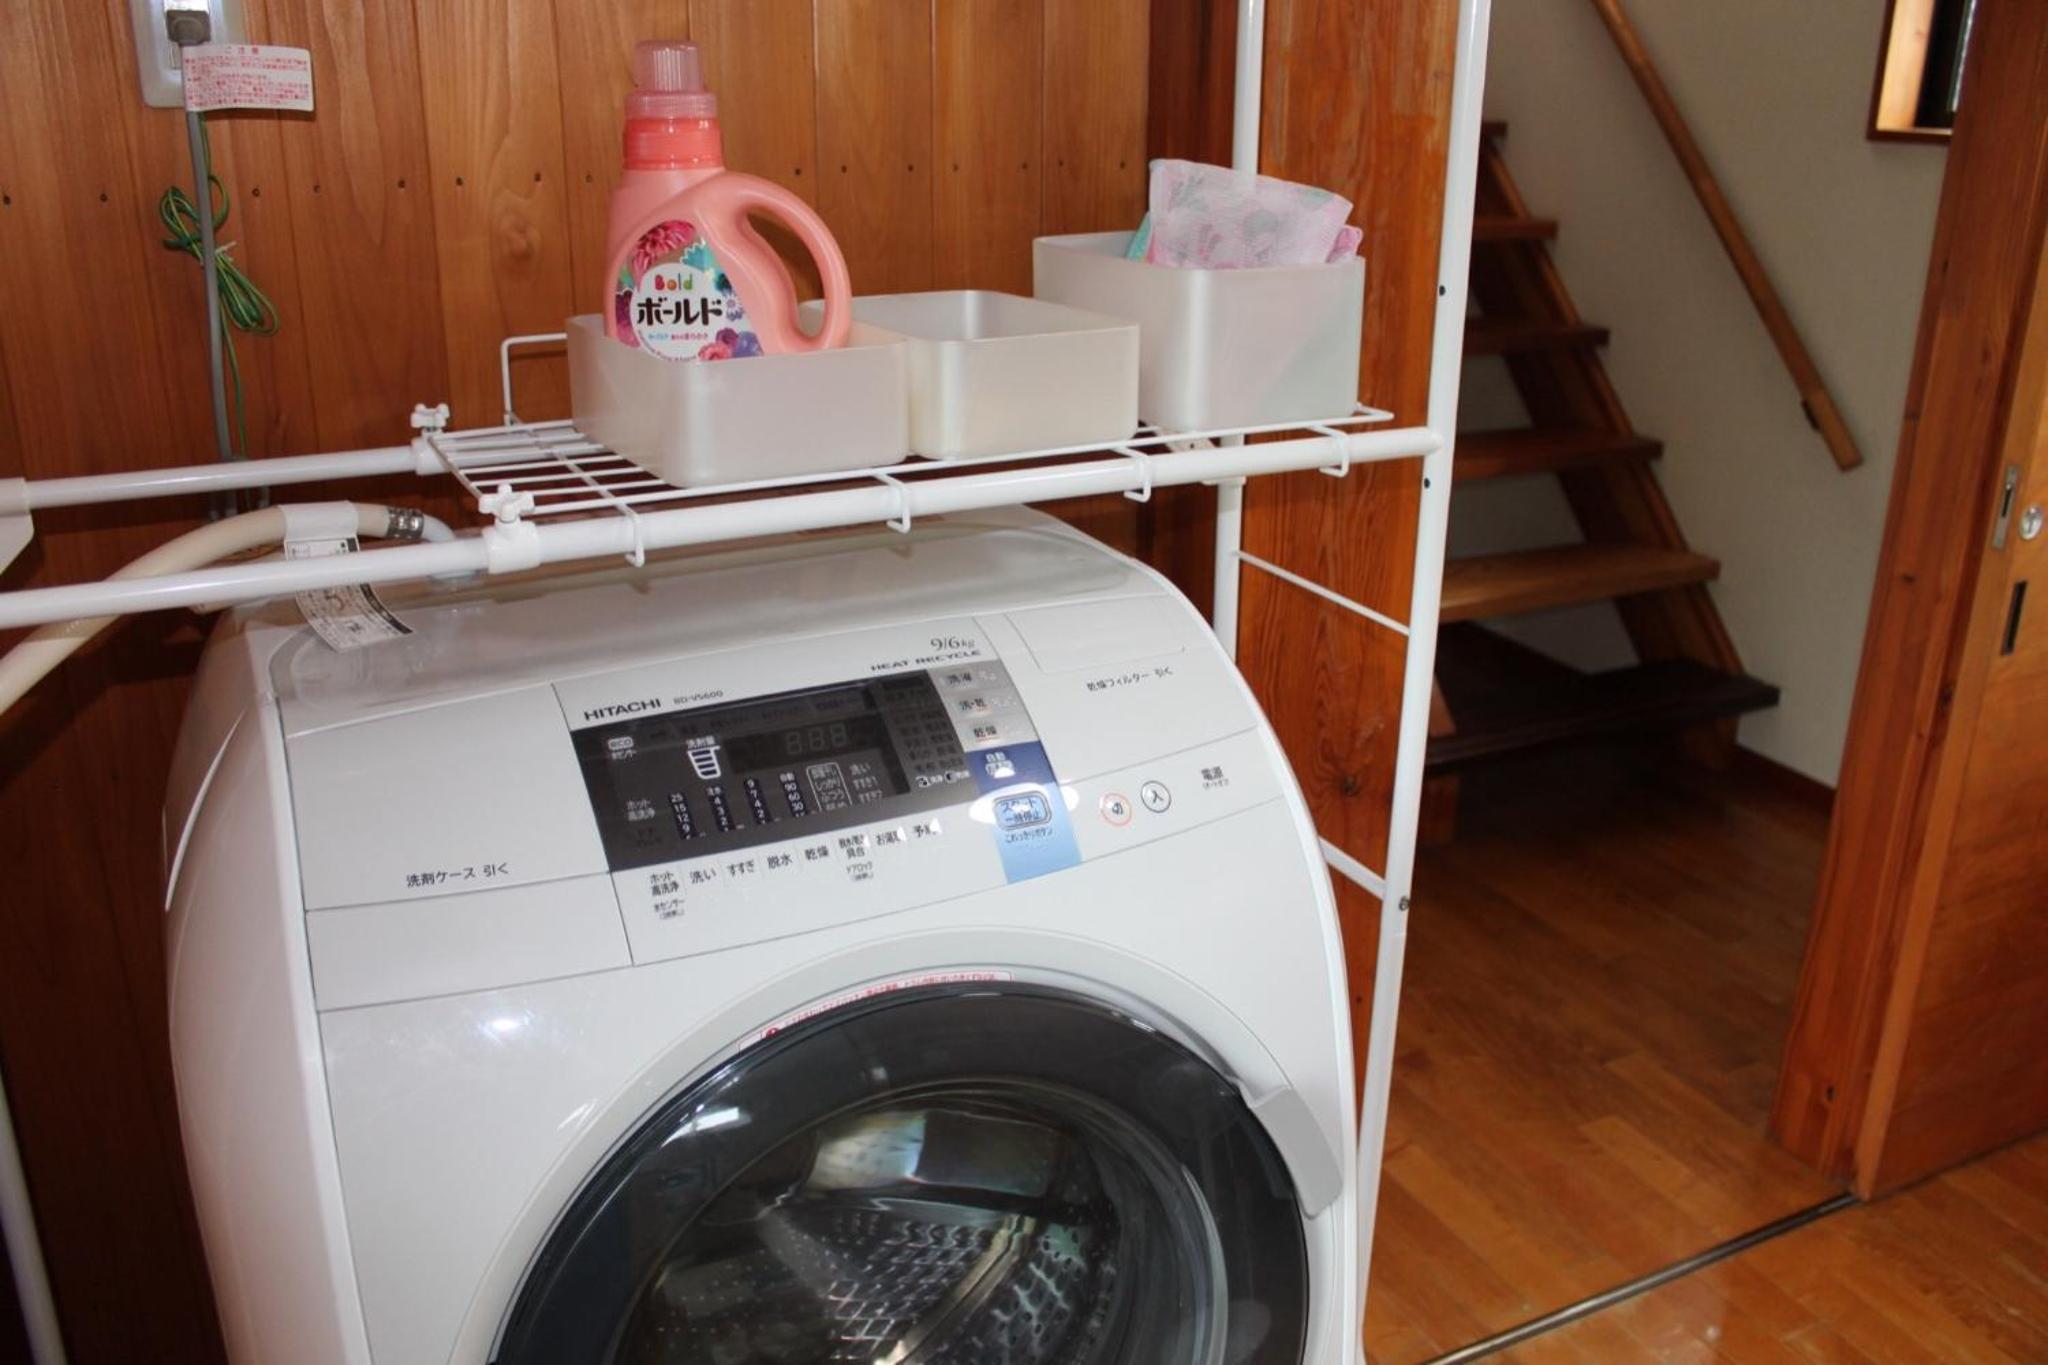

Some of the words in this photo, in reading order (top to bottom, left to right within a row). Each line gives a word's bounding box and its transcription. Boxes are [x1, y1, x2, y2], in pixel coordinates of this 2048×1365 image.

[655, 273, 693, 291] Bold
[637, 297, 723, 326] ボールド
[871, 659, 909, 672] HEAT
[915, 650, 982, 665] RECYCLE
[584, 698, 662, 721] HITACHI
[1201, 766, 1223, 781] 電源
[1152, 790, 1165, 804] 入
[767, 853, 793, 869] 脱水
[805, 847, 829, 861] 乾燥
[406, 867, 476, 888] 洗剤ケース
[484, 862, 510, 878] 引く
[690, 867, 717, 884] 洗い
[727, 860, 755, 877] すすぎ
